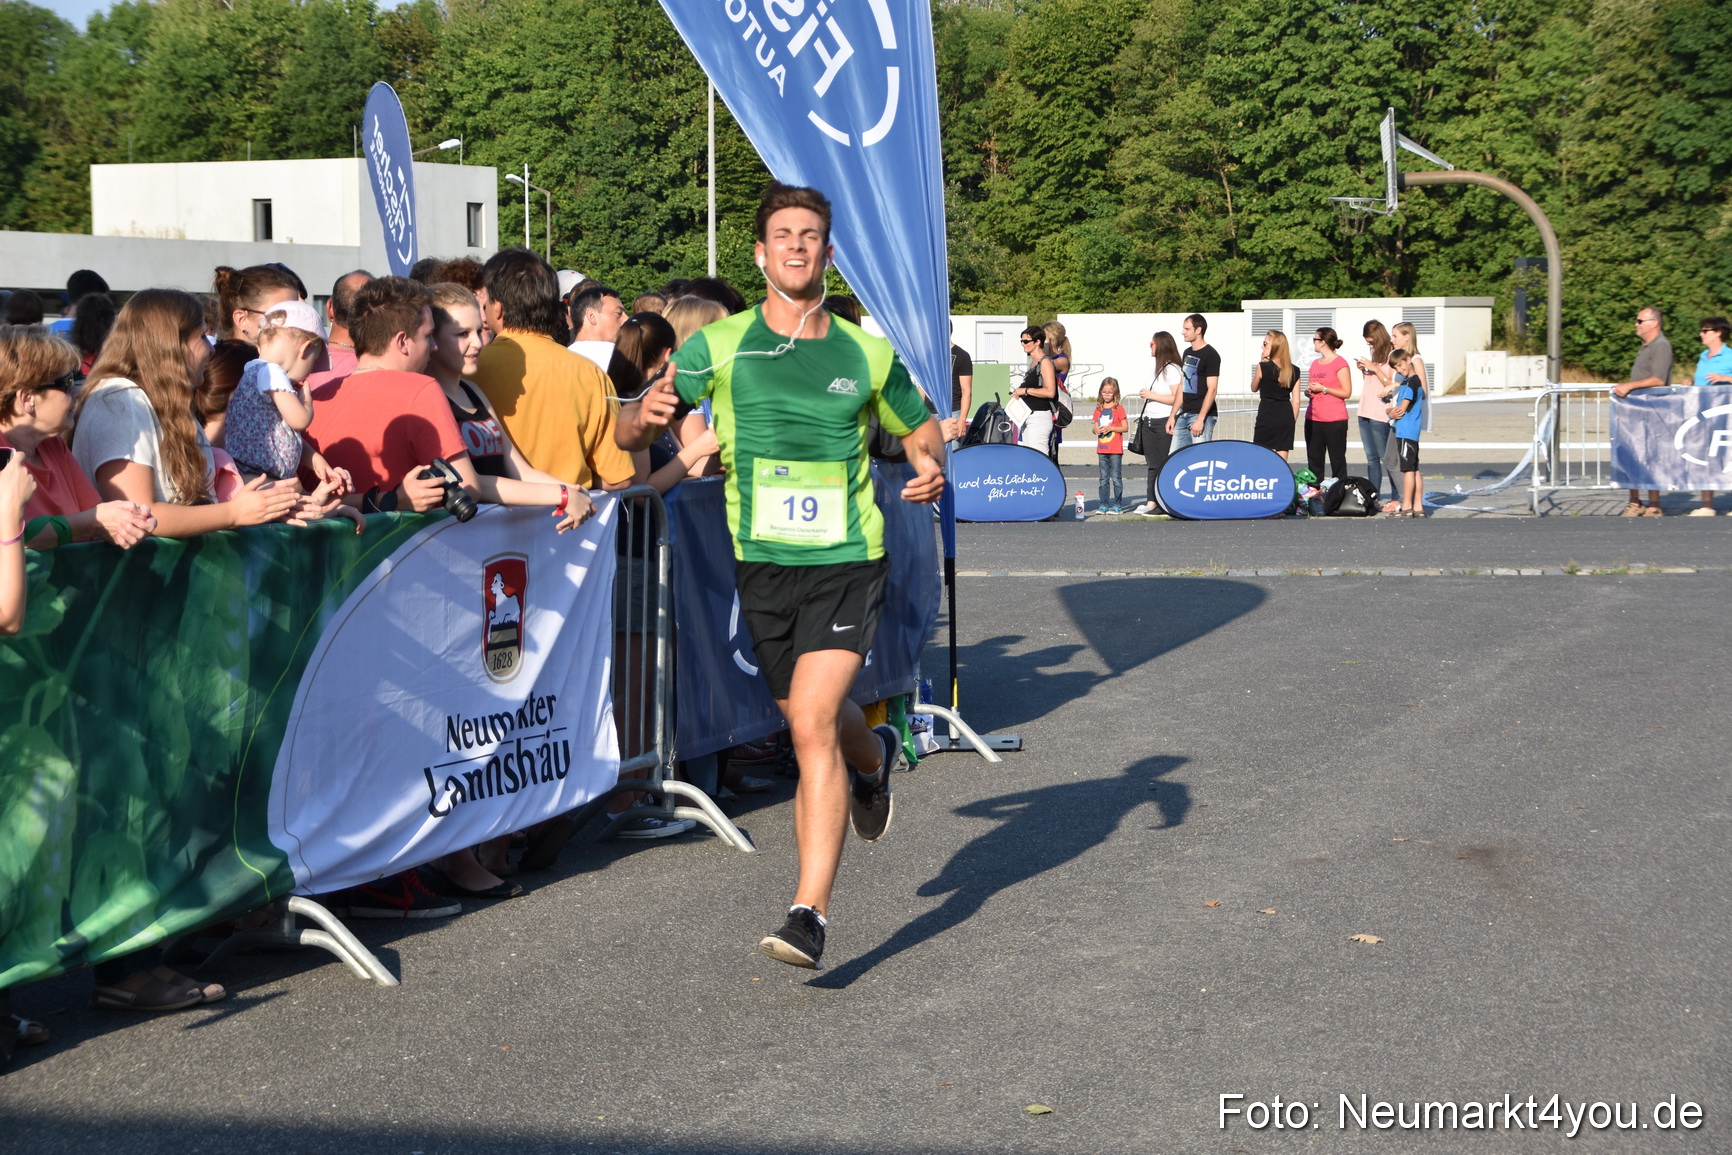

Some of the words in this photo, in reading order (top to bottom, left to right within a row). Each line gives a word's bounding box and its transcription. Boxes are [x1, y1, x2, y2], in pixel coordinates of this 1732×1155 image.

[827, 377, 859, 392] AOK
[959, 477, 980, 488] und
[983, 475, 1003, 485] das
[1194, 474, 1278, 492] Fischer
[988, 488, 1017, 502] fährt
[1020, 486, 1045, 496] mit!
[1203, 492, 1274, 501] AUTOMOBILE
[783, 495, 818, 522] 19
[492, 651, 513, 671] 1628
